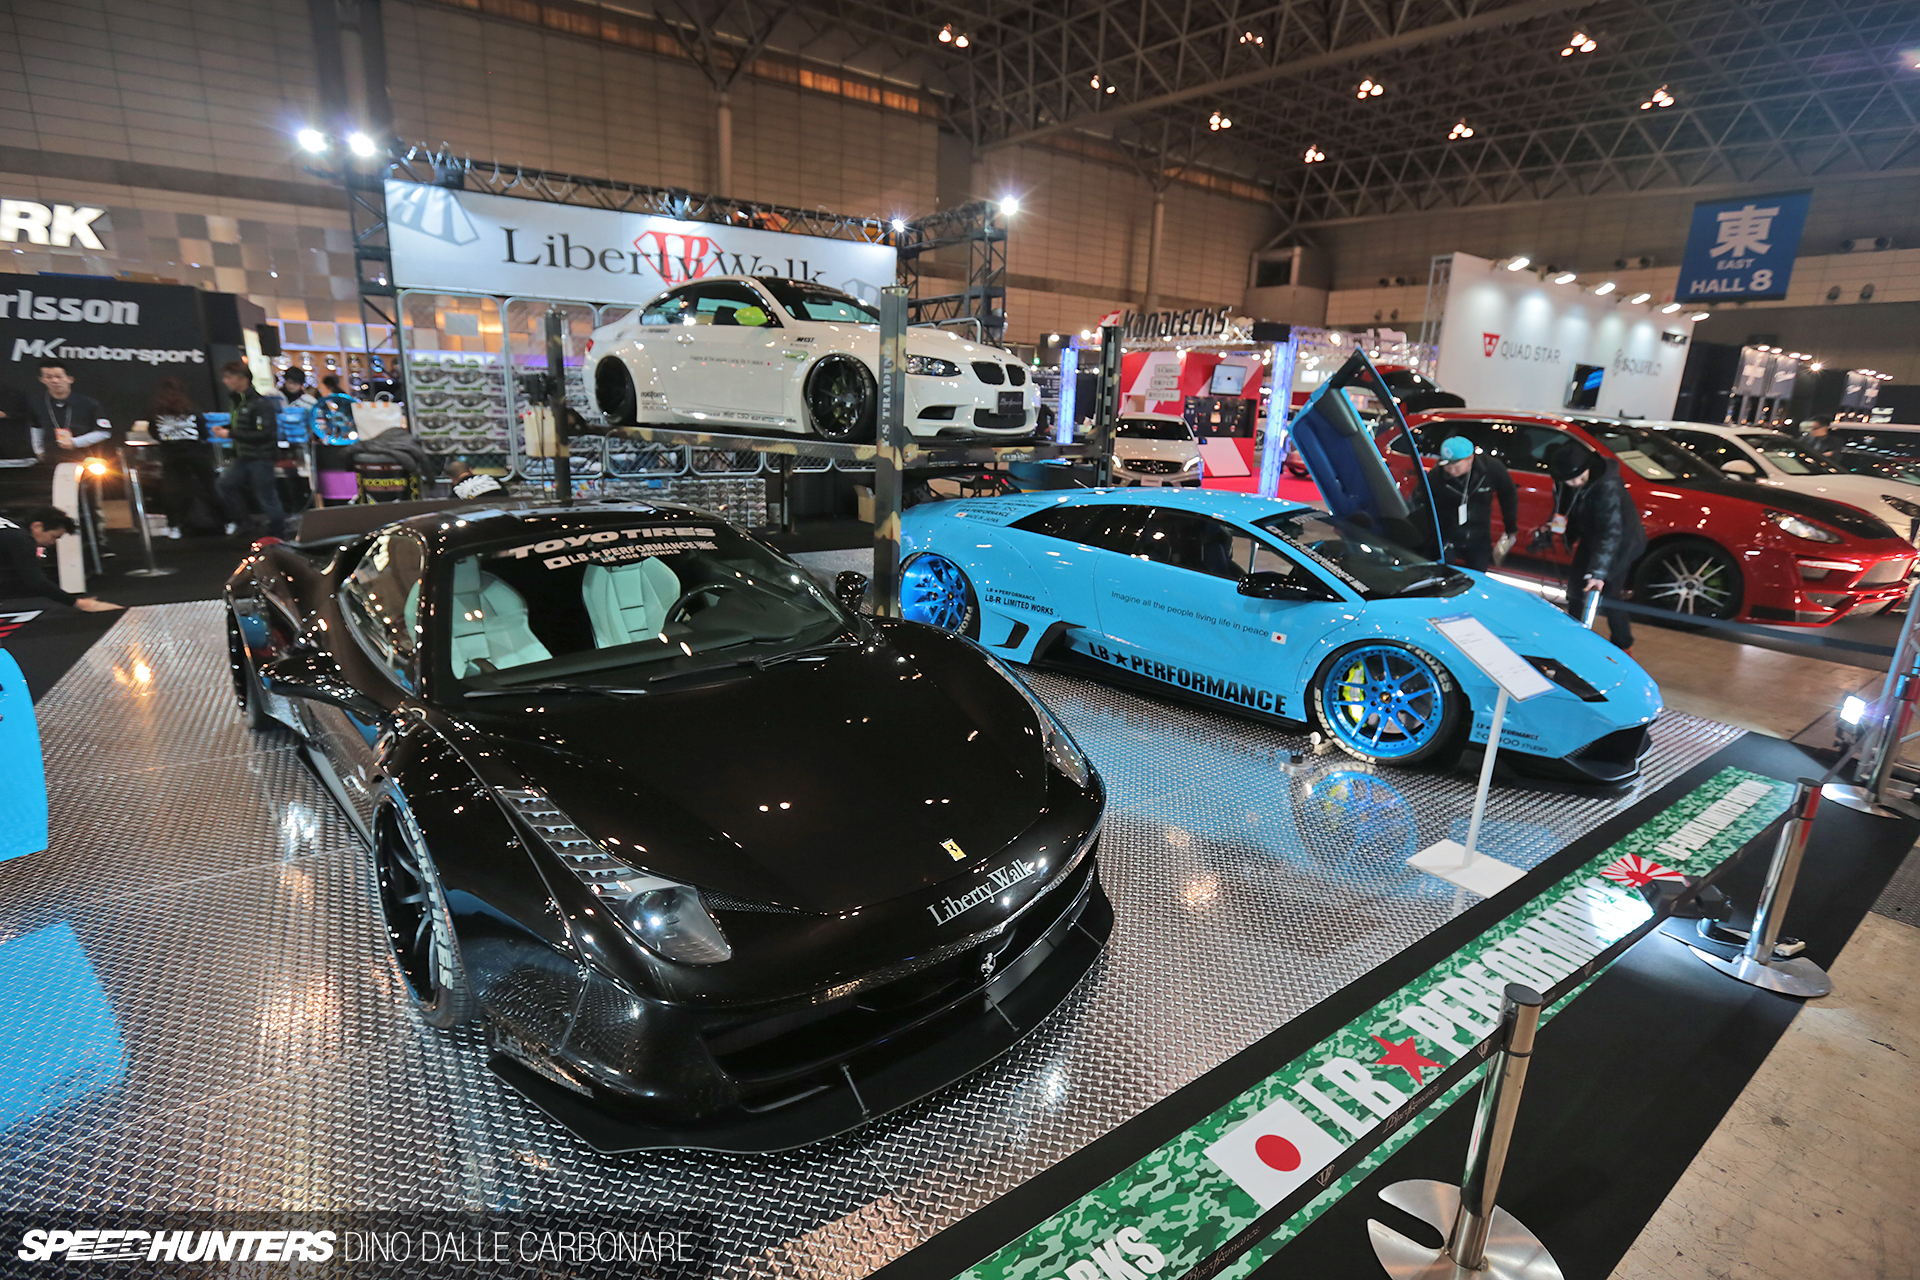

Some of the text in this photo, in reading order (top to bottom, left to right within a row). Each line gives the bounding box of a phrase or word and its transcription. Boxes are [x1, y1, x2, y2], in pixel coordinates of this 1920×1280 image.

[1709, 204, 1780, 258] 東
[499, 227, 827, 285] Liberty Walk
[1716, 258, 1755, 271] EAST
[1689, 269, 1774, 295] HALL 8
[0, 288, 140, 326] rlsson
[1501, 340, 1561, 364] QUAD STAR
[508, 526, 716, 560] TOYO TIRES
[569, 541, 699, 566] LB PERFORMANCE
[641, 549, 681, 559] WORKS
[998, 589, 1036, 601] PERFORMANCE
[1003, 598, 1030, 610] LIMITED
[1030, 603, 1055, 616] WORKS
[1111, 590, 1270, 638] Imagine all the people living life in peace
[1088, 641, 1288, 716] LB PERFORMANCE
[1693, 799, 1748, 831] LIMITED
[927, 858, 1036, 927] Liberty Walk
[1292, 1056, 1408, 1140] LB
